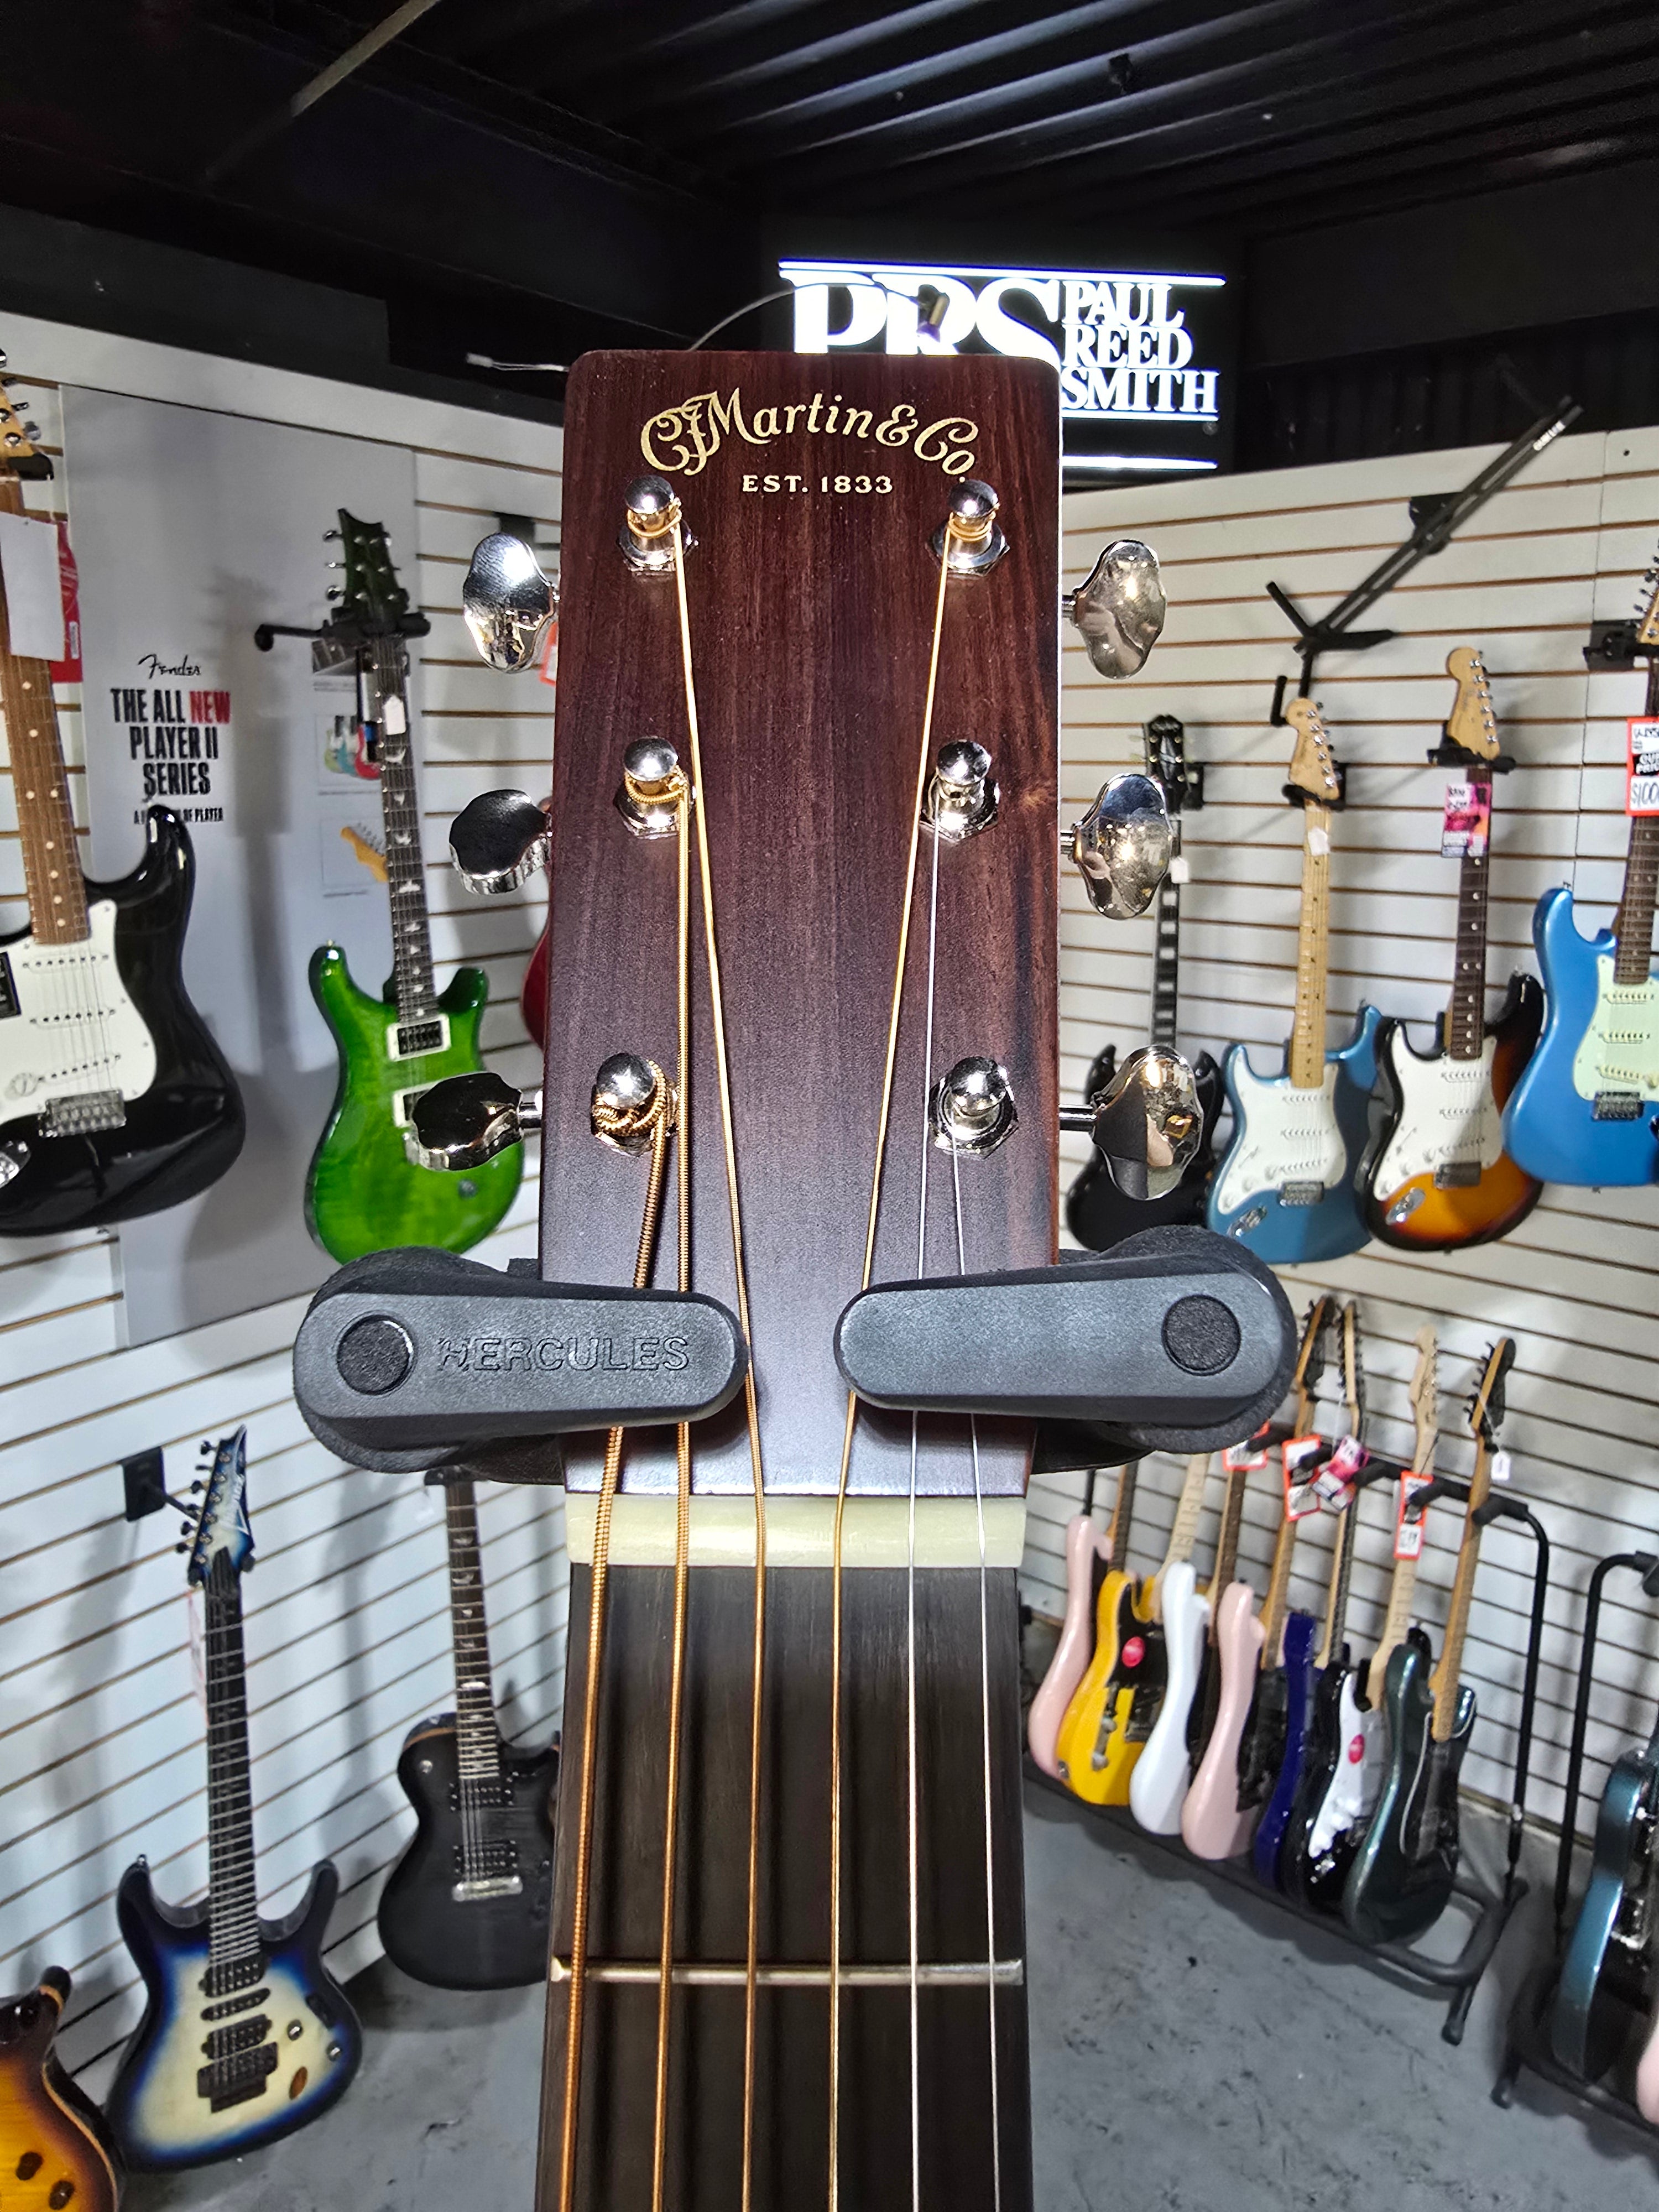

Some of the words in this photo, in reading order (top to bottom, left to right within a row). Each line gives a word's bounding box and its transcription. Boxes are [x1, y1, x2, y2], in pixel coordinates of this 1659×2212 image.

[1062, 279, 1185, 328] PAUL
[1062, 325, 1193, 369] REED
[1060, 366, 1220, 413] SMITH
[742, 474, 808, 493] EST.
[821, 475, 893, 493] 1833
[137, 653, 201, 680] Fender
[109, 688, 149, 723] THE
[153, 690, 186, 724] ALL
[189, 690, 231, 724] NEW
[129, 726, 201, 760] PLAYER
[204, 726, 219, 760] II
[142, 762, 211, 795] SERIES
[438, 1337, 690, 1372] HERCULES
